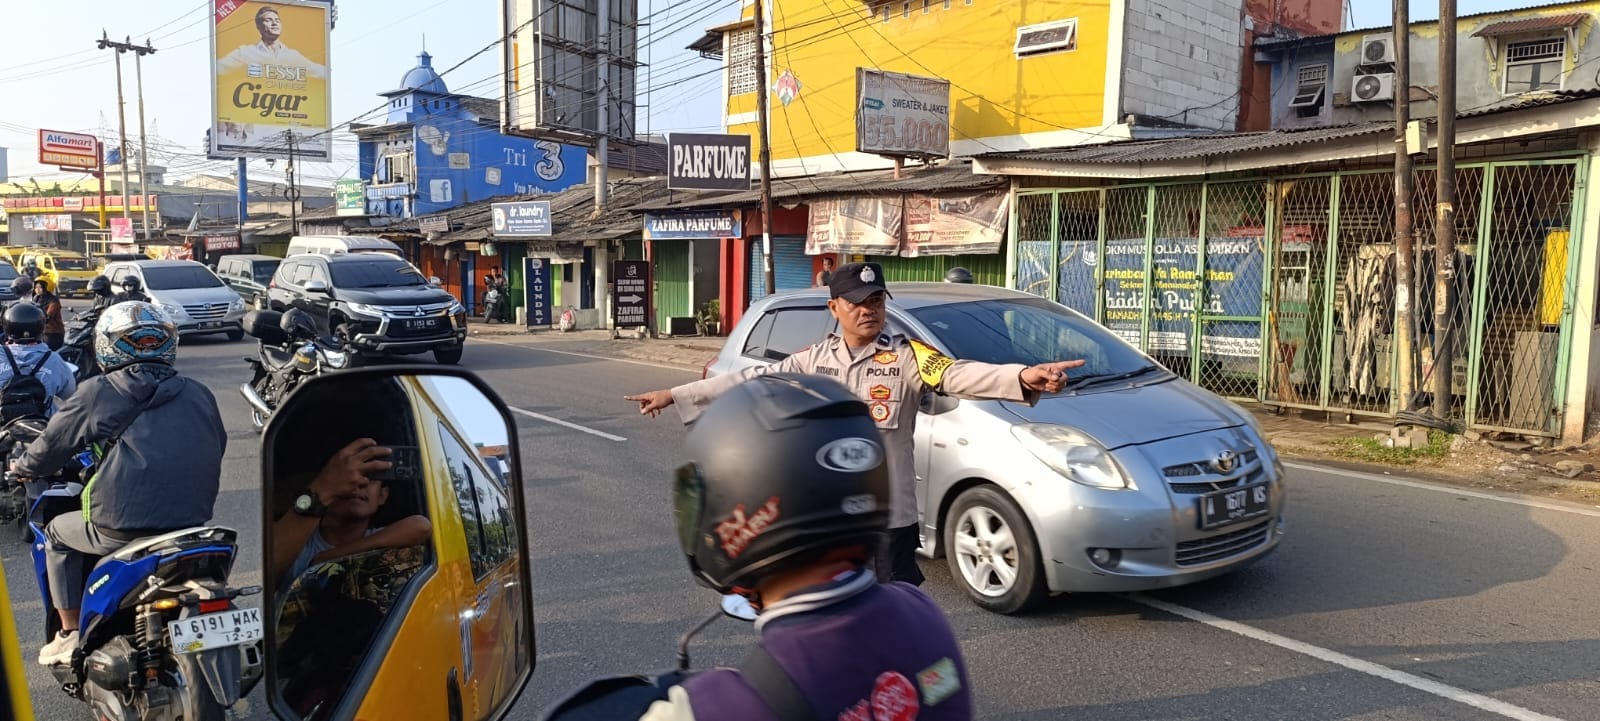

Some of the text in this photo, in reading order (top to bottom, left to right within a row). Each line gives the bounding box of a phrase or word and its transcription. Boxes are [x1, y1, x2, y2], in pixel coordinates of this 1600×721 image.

[216, 0, 237, 18] NEW
[265, 64, 307, 81] ESSE
[233, 82, 308, 117] Cigar
[892, 98, 947, 115] SWEATER & JAKET
[46, 134, 92, 147] Alfamart
[865, 116, 947, 149] 55.000
[503, 147, 527, 166] Tri
[534, 140, 565, 181] 3
[673, 144, 747, 179] PARFUME
[514, 182, 526, 194] You
[652, 217, 732, 232] ZAFIRA PARFUME
[1127, 244, 1181, 255] MUSOLLA
[534, 269, 543, 324] LAUNDRY
[618, 306, 644, 315] ZAFIRA
[618, 315, 644, 323] PARFUME
[866, 367, 900, 377] POLRI
[1206, 497, 1216, 516] A
[173, 609, 260, 638] A 6191 WAK
[225, 628, 260, 643] 12-27
